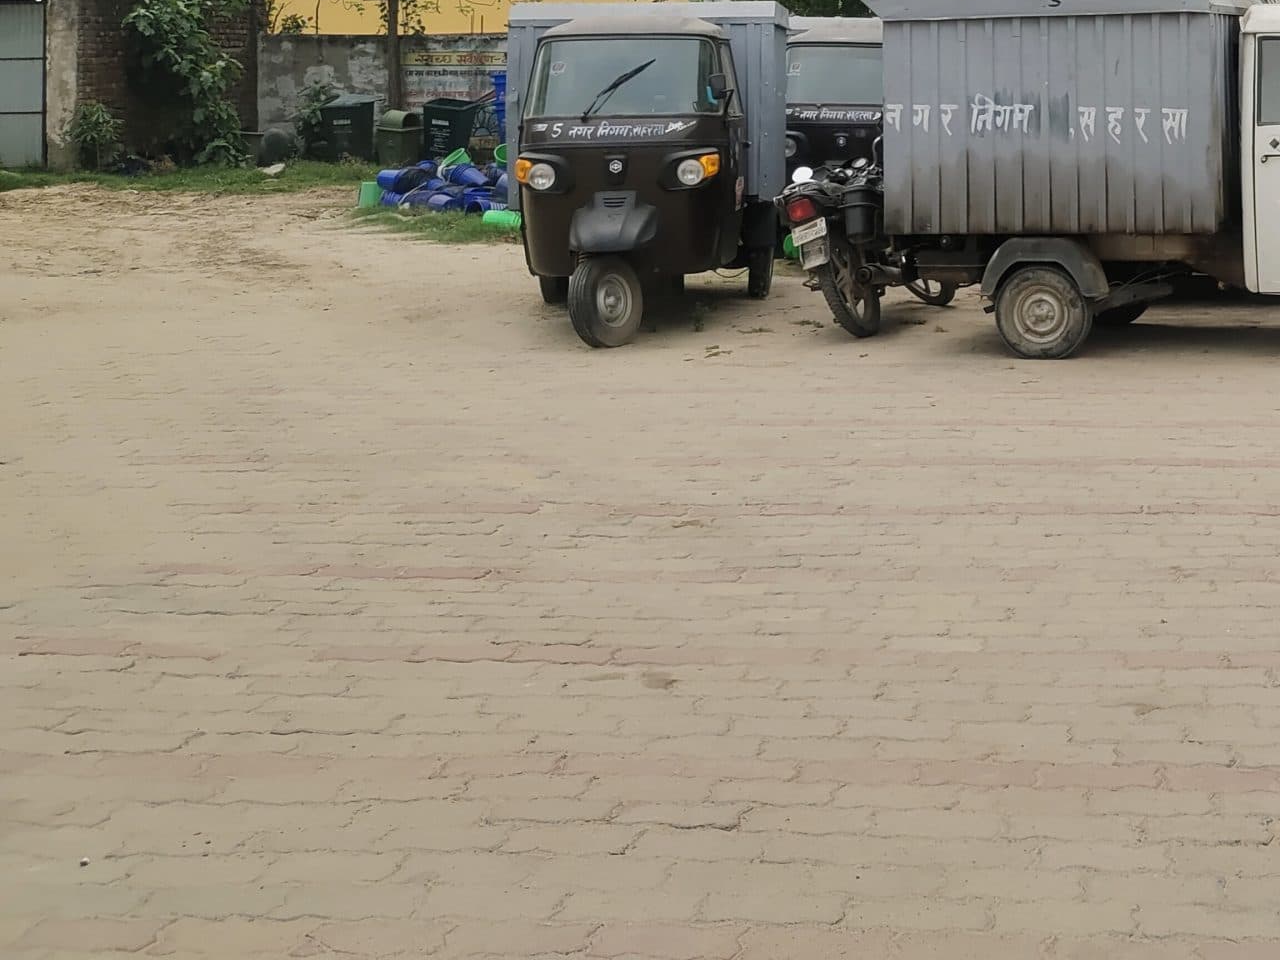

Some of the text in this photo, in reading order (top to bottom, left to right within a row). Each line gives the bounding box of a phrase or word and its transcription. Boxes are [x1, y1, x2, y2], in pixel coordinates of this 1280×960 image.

[970, 93, 1034, 134] निगम
[551, 123, 563, 138] 5
[568, 126, 595, 140] नगर
